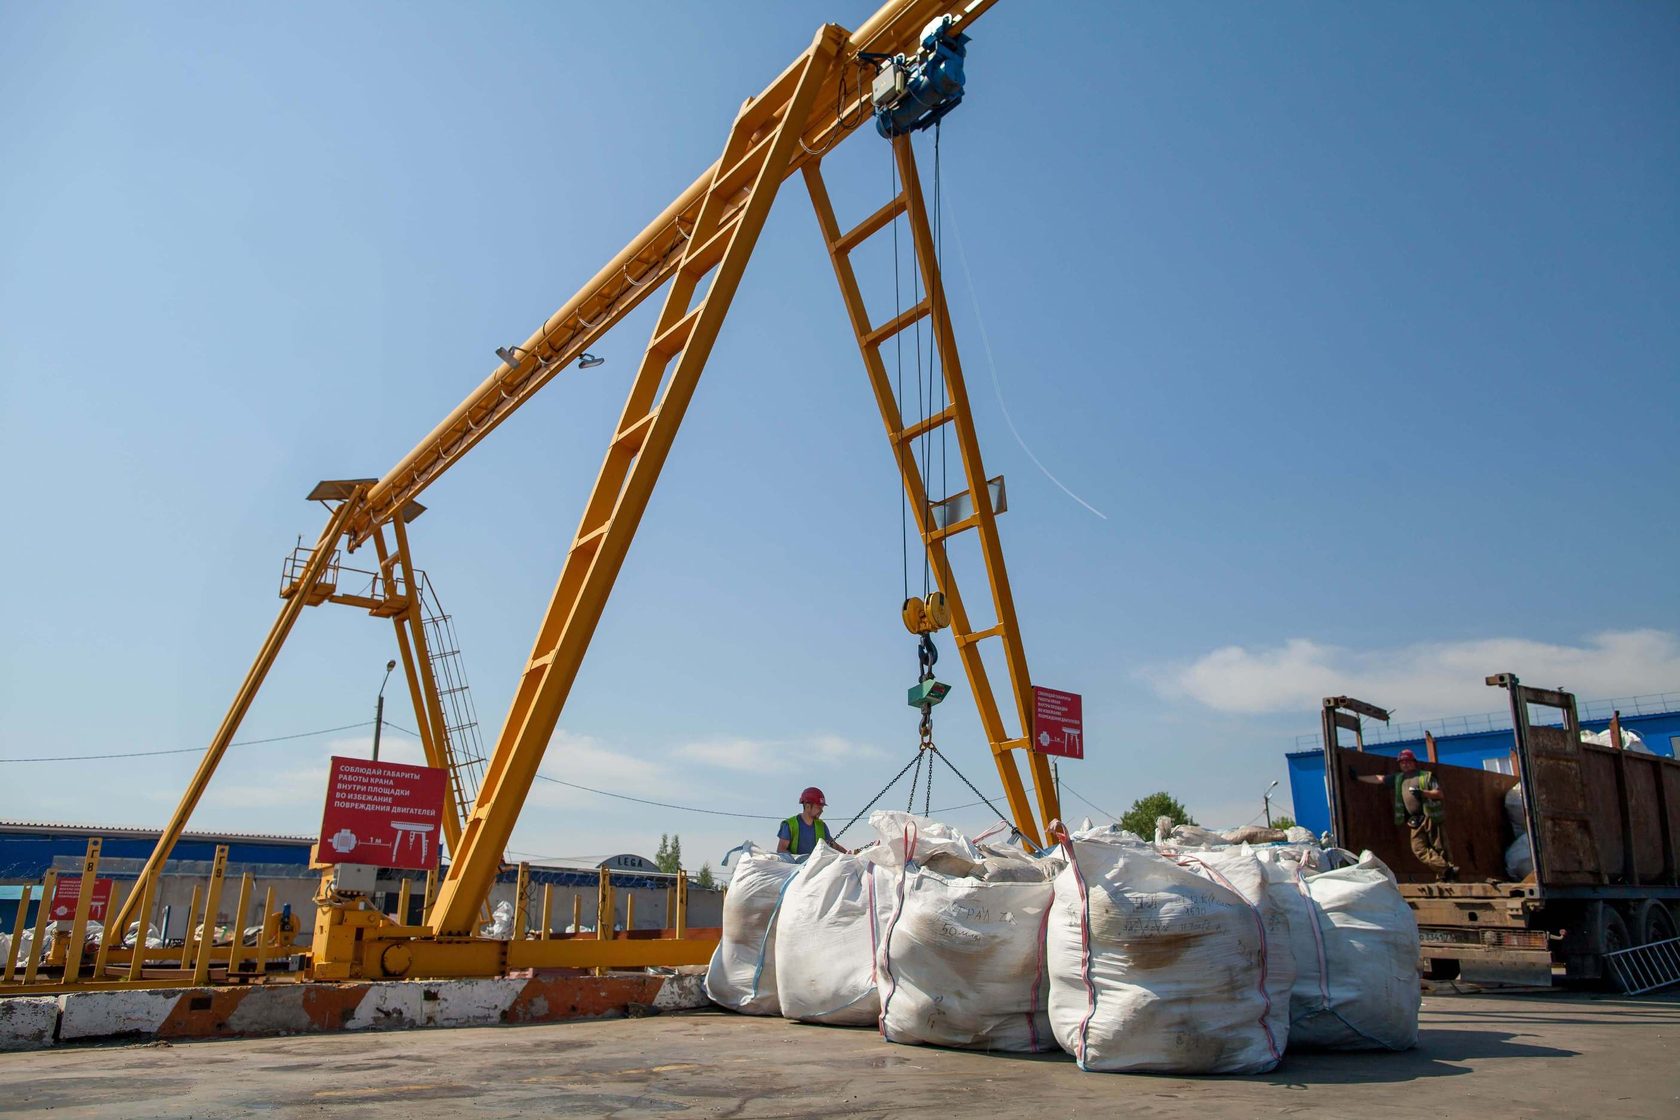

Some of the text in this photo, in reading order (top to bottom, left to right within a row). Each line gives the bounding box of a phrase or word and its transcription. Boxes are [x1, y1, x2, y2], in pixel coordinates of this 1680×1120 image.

[340, 765, 420, 780] СОБЛЮДАЙ ГАБАРИТЫ
[338, 774, 394, 786] РАБОТЫ КРАНА
[337, 783, 410, 797] ВНУТРИ ПЛОЩАДКИ
[347, 793, 393, 804] ИЗБЕЖАНИЕ
[335, 801, 436, 816] ПОВРЕЖДЕНИЯ ДВИГАТЕЛЕЙ
[617, 857, 643, 868] LEGA
